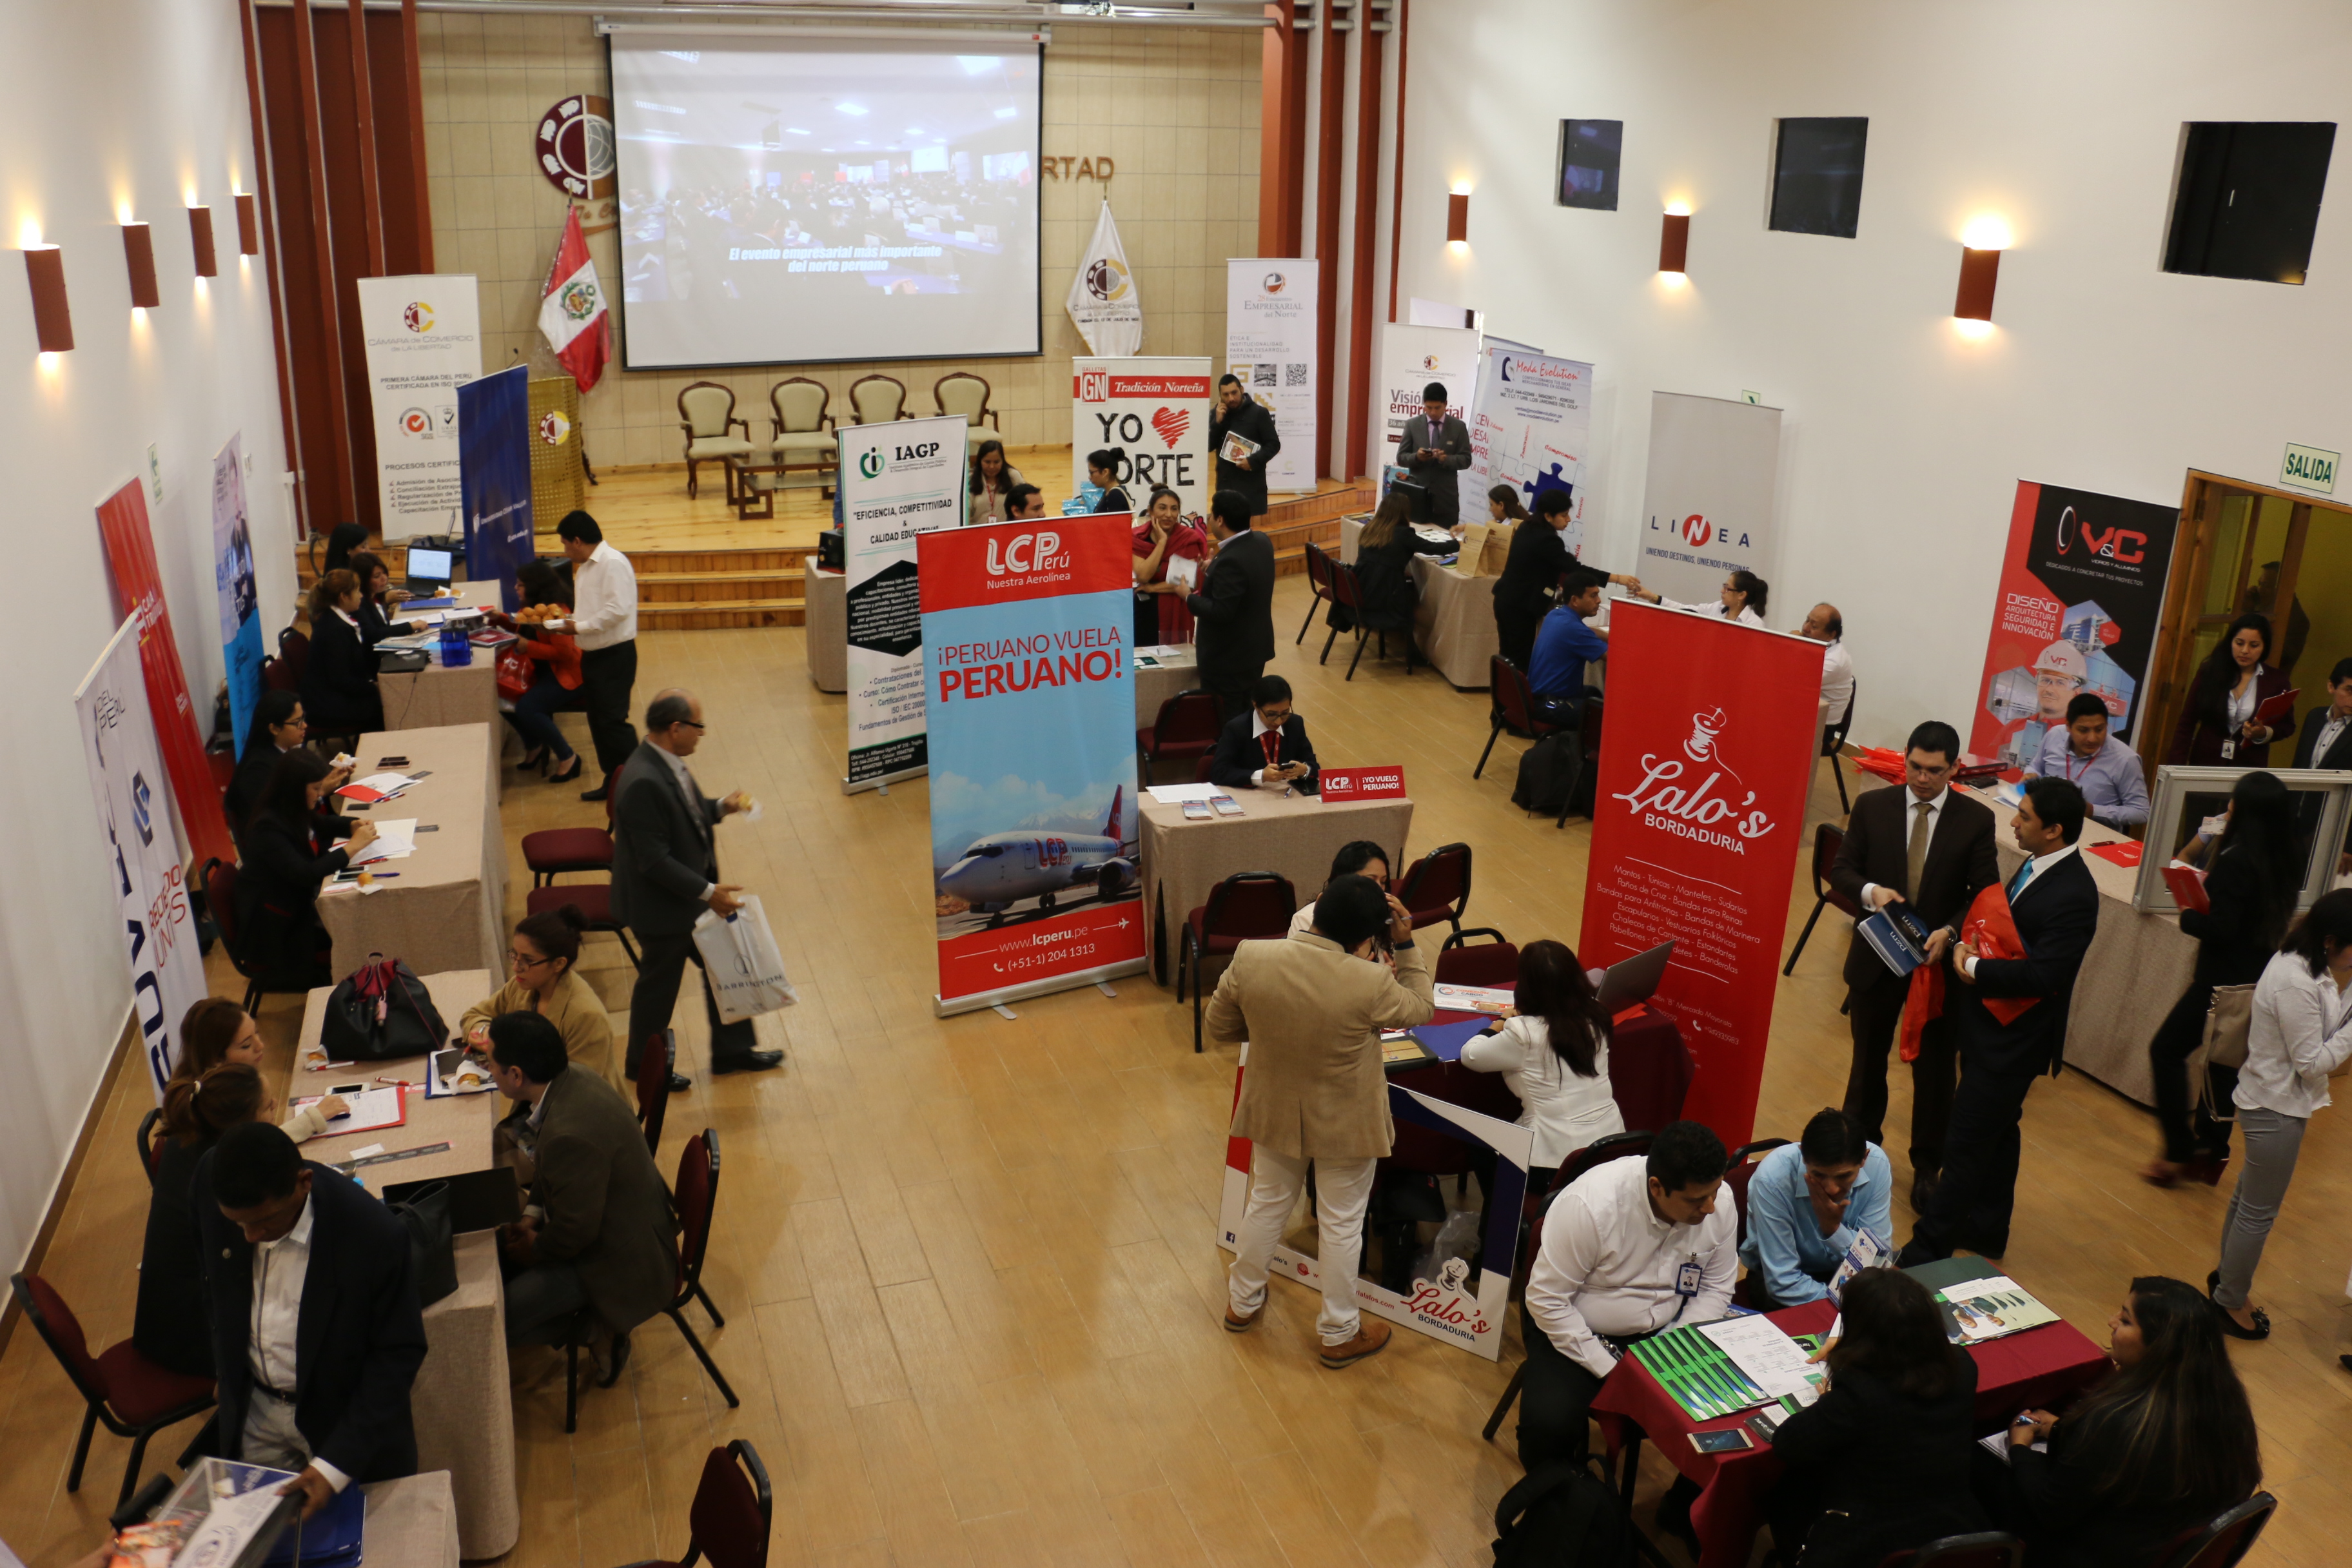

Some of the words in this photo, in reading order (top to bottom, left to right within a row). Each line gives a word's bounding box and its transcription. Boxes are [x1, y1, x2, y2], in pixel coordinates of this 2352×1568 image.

[1041, 156, 1114, 179] RTAD
[729, 248, 741, 260] El
[741, 248, 781, 260] evento
[782, 246, 852, 260] empresarial
[853, 245, 878, 258] más
[880, 245, 943, 259] importante
[788, 260, 807, 273] del
[808, 260, 839, 272] norte
[841, 260, 888, 273] peruano
[1516, 359, 1537, 373] Moda
[1540, 362, 1578, 380] Evolution
[1083, 374, 1106, 400] GN
[1114, 381, 1161, 393] Tradición
[1163, 382, 1204, 393] Norteña
[1095, 413, 1142, 443] YO
[895, 442, 939, 460] IAGP
[1544, 444, 1577, 462] Compromiso
[385, 462, 425, 471] PROCESOS
[1117, 453, 1195, 486] ORTE
[2286, 453, 2332, 484] SALIDA
[899, 499, 952, 514] COMPETITIVIDAD
[870, 533, 898, 544] CALIDAD
[1651, 514, 1750, 547] LINEA
[2081, 522, 2148, 564] V&C
[1646, 547, 1668, 558] UNIENDO
[1698, 556, 1721, 569] UNIENDO
[987, 577, 1024, 589] Nuestra
[1026, 571, 1070, 584] Aerolínea
[2046, 562, 2071, 571] DEDICADOS
[2077, 568, 2104, 578] CONCRETAR
[2115, 576, 2144, 586] PROYECTOS
[2005, 605, 2056, 622] ARQUITECTURA
[2006, 593, 2059, 613] DISEÑO
[2002, 622, 2053, 640] INNOVACIÓN
[2004, 612, 2048, 629] SEGURIDAD
[2050, 623, 2055, 631] E
[937, 634, 1050, 666] ¡PERUANO
[1054, 626, 1121, 651] VUELA
[874, 671, 912, 684] Contrataciones
[897, 680, 919, 691] Contratar
[939, 649, 1122, 703] PERUANO!
[878, 695, 906, 706] Certificación
[859, 720, 890, 731] Fundamentos
[899, 712, 916, 721] Gestión
[1645, 813, 1745, 856] BORDADURIA
[1613, 865, 1641, 879] Mantos
[1648, 874, 1670, 889] Túnicas
[1676, 885, 1712, 901] Manteles
[1718, 897, 1747, 915] Sudarios
[1617, 877, 1638, 890] Paños
[1639, 884, 1649, 894] de
[1651, 888, 1667, 901] Cruz
[1673, 896, 1701, 911] Bandas
[1703, 906, 1720, 917] para
[1722, 910, 1743, 926] Reinas
[1597, 883, 1623, 898] Bandas
[1624, 894, 1642, 905] para
[1643, 898, 1678, 917] Anfitrionas
[1685, 912, 1714, 927] Bandas
[1715, 920, 1725, 931] de
[1725, 925, 1760, 943] Marinera
[1618, 901, 1660, 922] Escapularios
[1665, 917, 1701, 936] Vestuarios
[1703, 929, 1736, 948] Folklóricos
[999, 926, 1088, 953] www.lcperu.pe
[1612, 912, 1645, 929] Chalecos
[1646, 923, 1656, 934] de
[1658, 928, 1689, 945] Cantante
[1696, 939, 1736, 961] Estandartes
[1007, 952, 1045, 972] (+51-1)
[1047, 948, 1067, 962] 204
[1070, 943, 1095, 957] 1313
[1609, 923, 1645, 941] Pabellones
[1700, 952, 1738, 974] Banderolas
[1651, 994, 1665, 1003] ellón
[1676, 1002, 1703, 1016] Mercado
[1705, 1011, 1732, 1028] Mayorista
[1273, 1255, 1288, 1266] alo's
[1418, 1313, 1475, 1342] BORDADURIA
